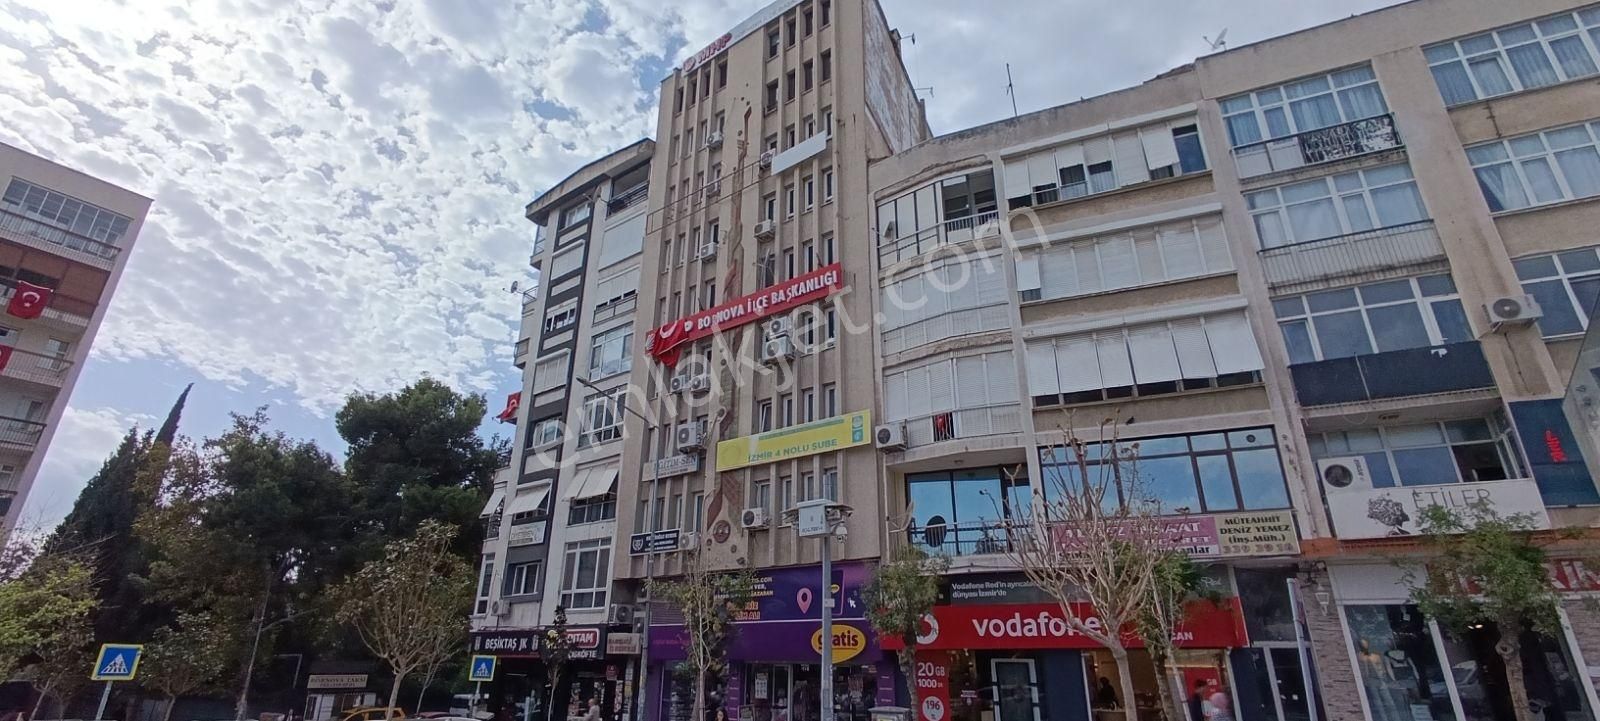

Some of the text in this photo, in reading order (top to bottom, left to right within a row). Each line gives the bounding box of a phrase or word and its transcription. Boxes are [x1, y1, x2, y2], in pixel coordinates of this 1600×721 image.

[698, 270, 838, 330] BORNOVA İLÇE BAŞKANLIĞI
[1412, 487, 1496, 509] ETİLER
[1224, 515, 1280, 525] MÜTEAHHİT
[1220, 524, 1290, 535] DENİZ YEMEZ
[952, 582, 984, 590] Vodafone
[972, 612, 1101, 637] vodafone
[818, 630, 859, 650] atis
[917, 662, 945, 677] 20 GB
[917, 679, 937, 688] 1000
[926, 700, 940, 710] 196
